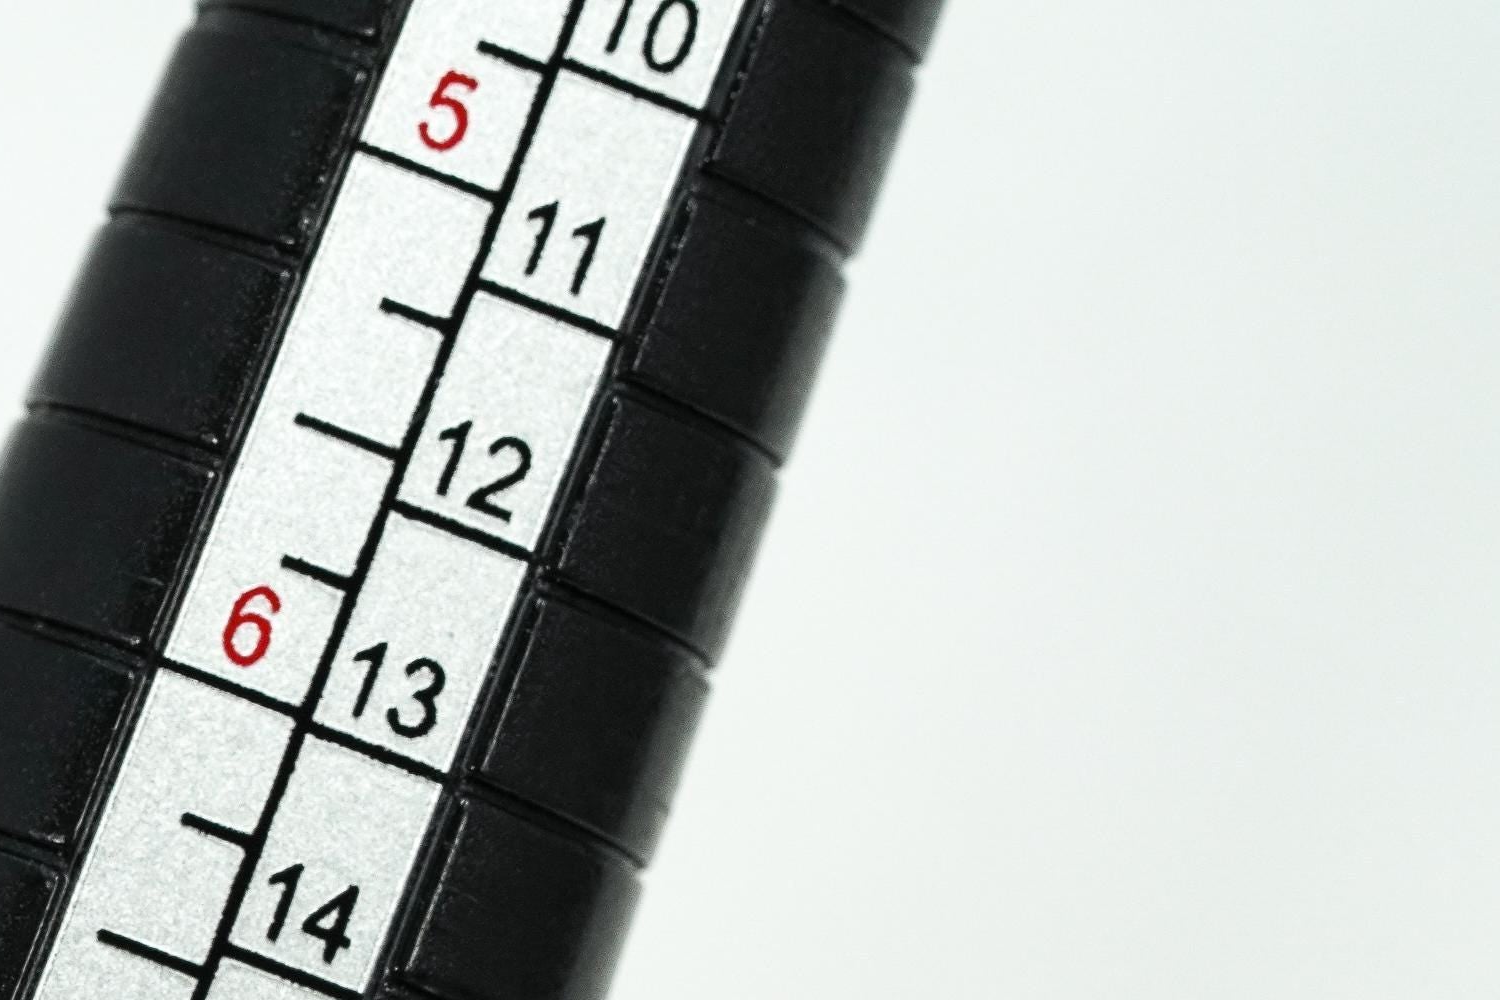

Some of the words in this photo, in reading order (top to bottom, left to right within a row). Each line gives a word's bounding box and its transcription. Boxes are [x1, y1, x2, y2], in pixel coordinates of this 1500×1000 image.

[605, 0, 699, 74] 10
[418, 70, 479, 152] 5
[524, 200, 607, 296] 11
[436, 420, 532, 523] 12
[221, 585, 281, 668] 6
[352, 642, 446, 739] 13
[266, 863, 360, 965] 14
